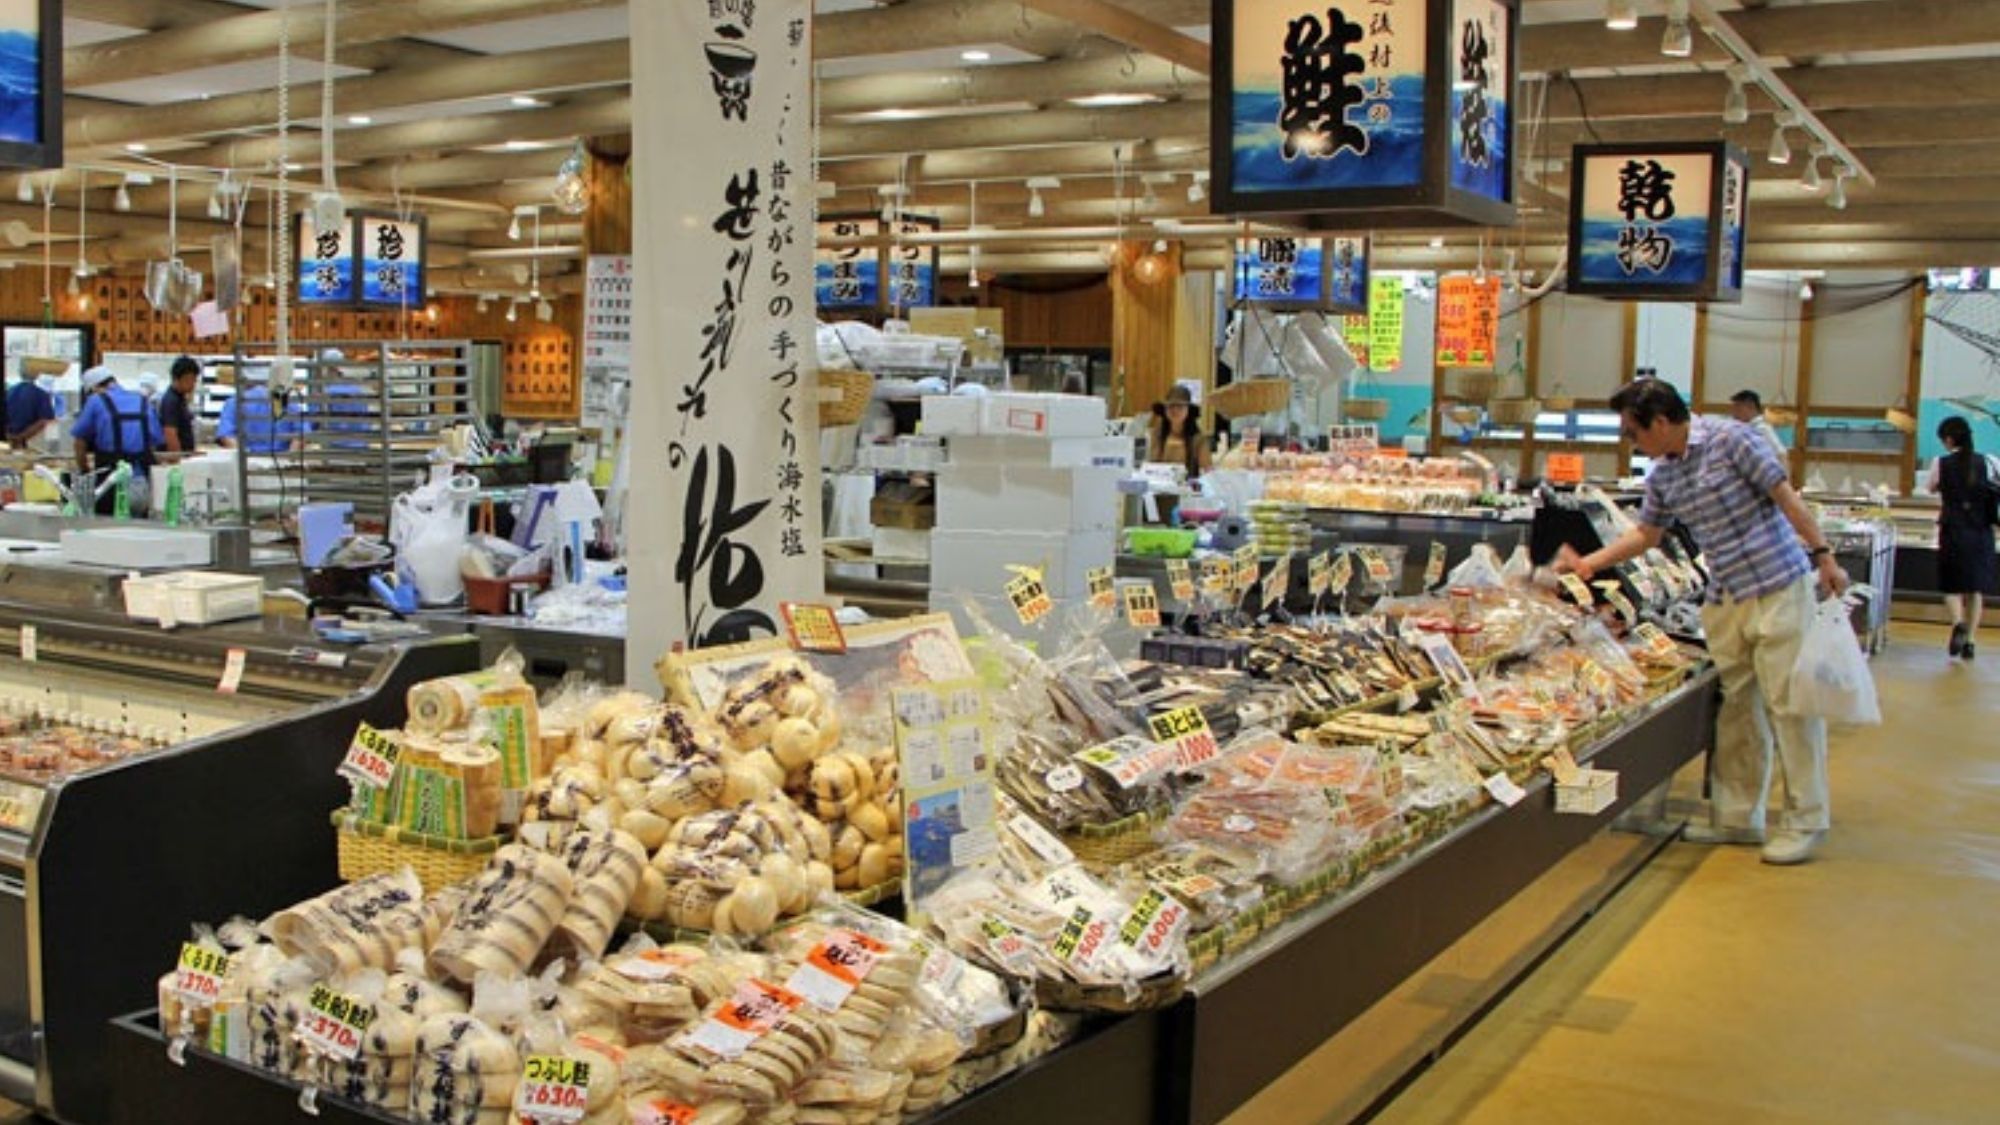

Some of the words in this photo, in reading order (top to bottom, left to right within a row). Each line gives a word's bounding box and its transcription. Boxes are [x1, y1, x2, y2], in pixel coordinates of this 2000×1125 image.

[1280, 8, 1366, 160] 鮭
[377, 223, 404, 295] 珍味
[1617, 160, 1676, 274] 乾物
[526, 1058, 591, 1087] つぶし麩
